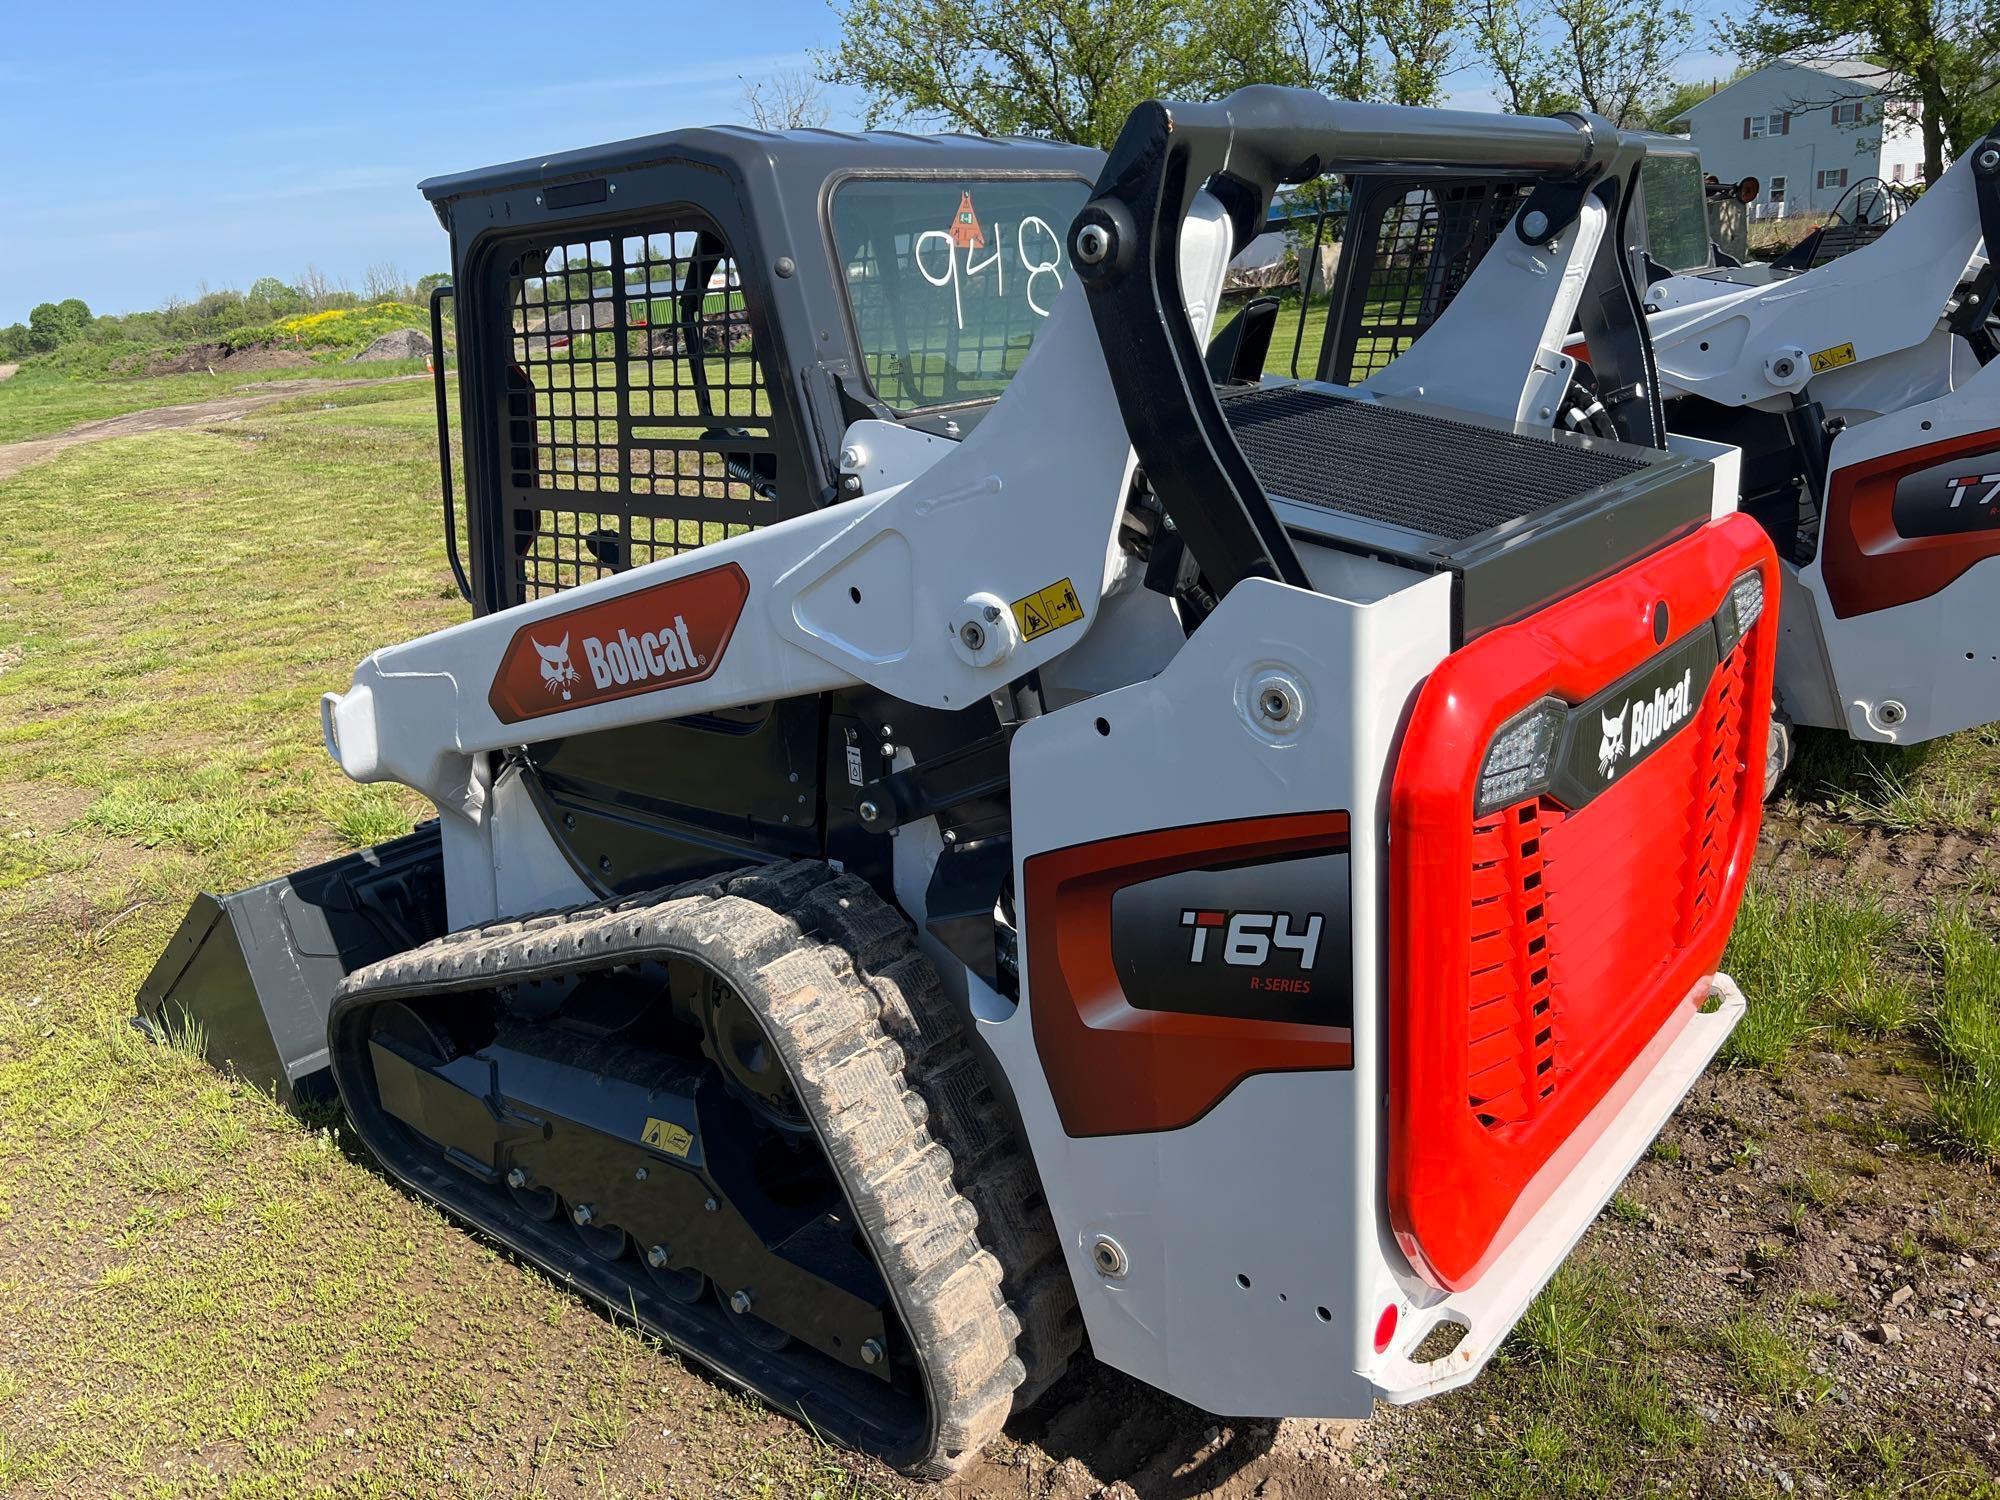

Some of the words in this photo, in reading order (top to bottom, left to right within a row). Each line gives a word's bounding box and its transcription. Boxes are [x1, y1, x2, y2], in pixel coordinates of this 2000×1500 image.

[915, 216, 1064, 329] 948
[582, 615, 699, 690] Bobcat
[1629, 667, 1692, 758] Bobcat
[1182, 911, 1324, 969] T64
[1250, 976, 1311, 994] R-SERIES
